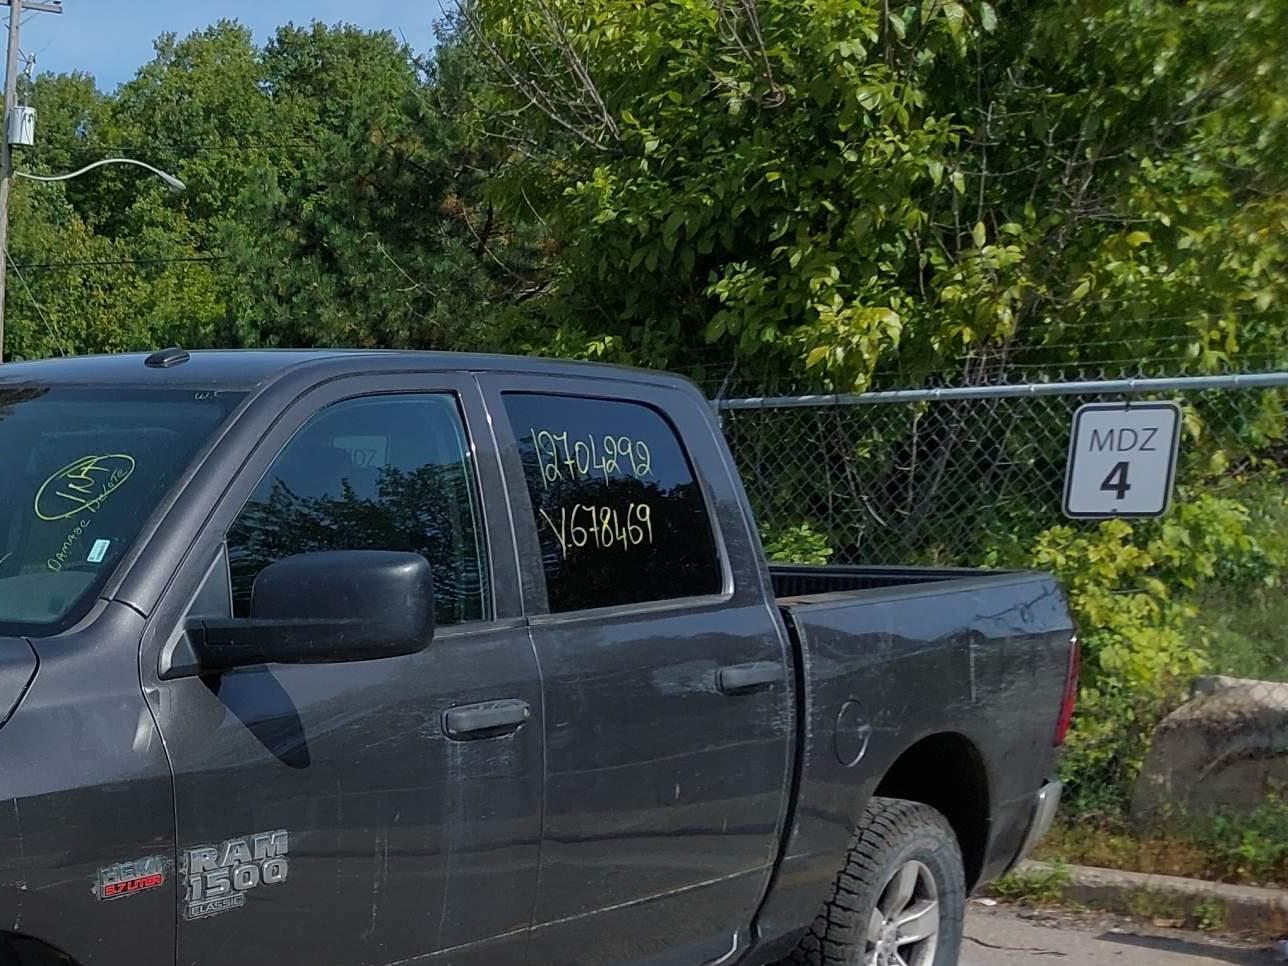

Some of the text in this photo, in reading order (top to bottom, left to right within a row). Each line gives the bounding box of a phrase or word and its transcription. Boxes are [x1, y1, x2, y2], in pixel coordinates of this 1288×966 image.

[530, 427, 653, 491] 12704292
[1089, 428, 1158, 452] MDZ
[1099, 461, 1131, 500] 4
[189, 829, 289, 875] RAM
[190, 858, 289, 900] 1500
[190, 895, 245, 917] CLASSIC
